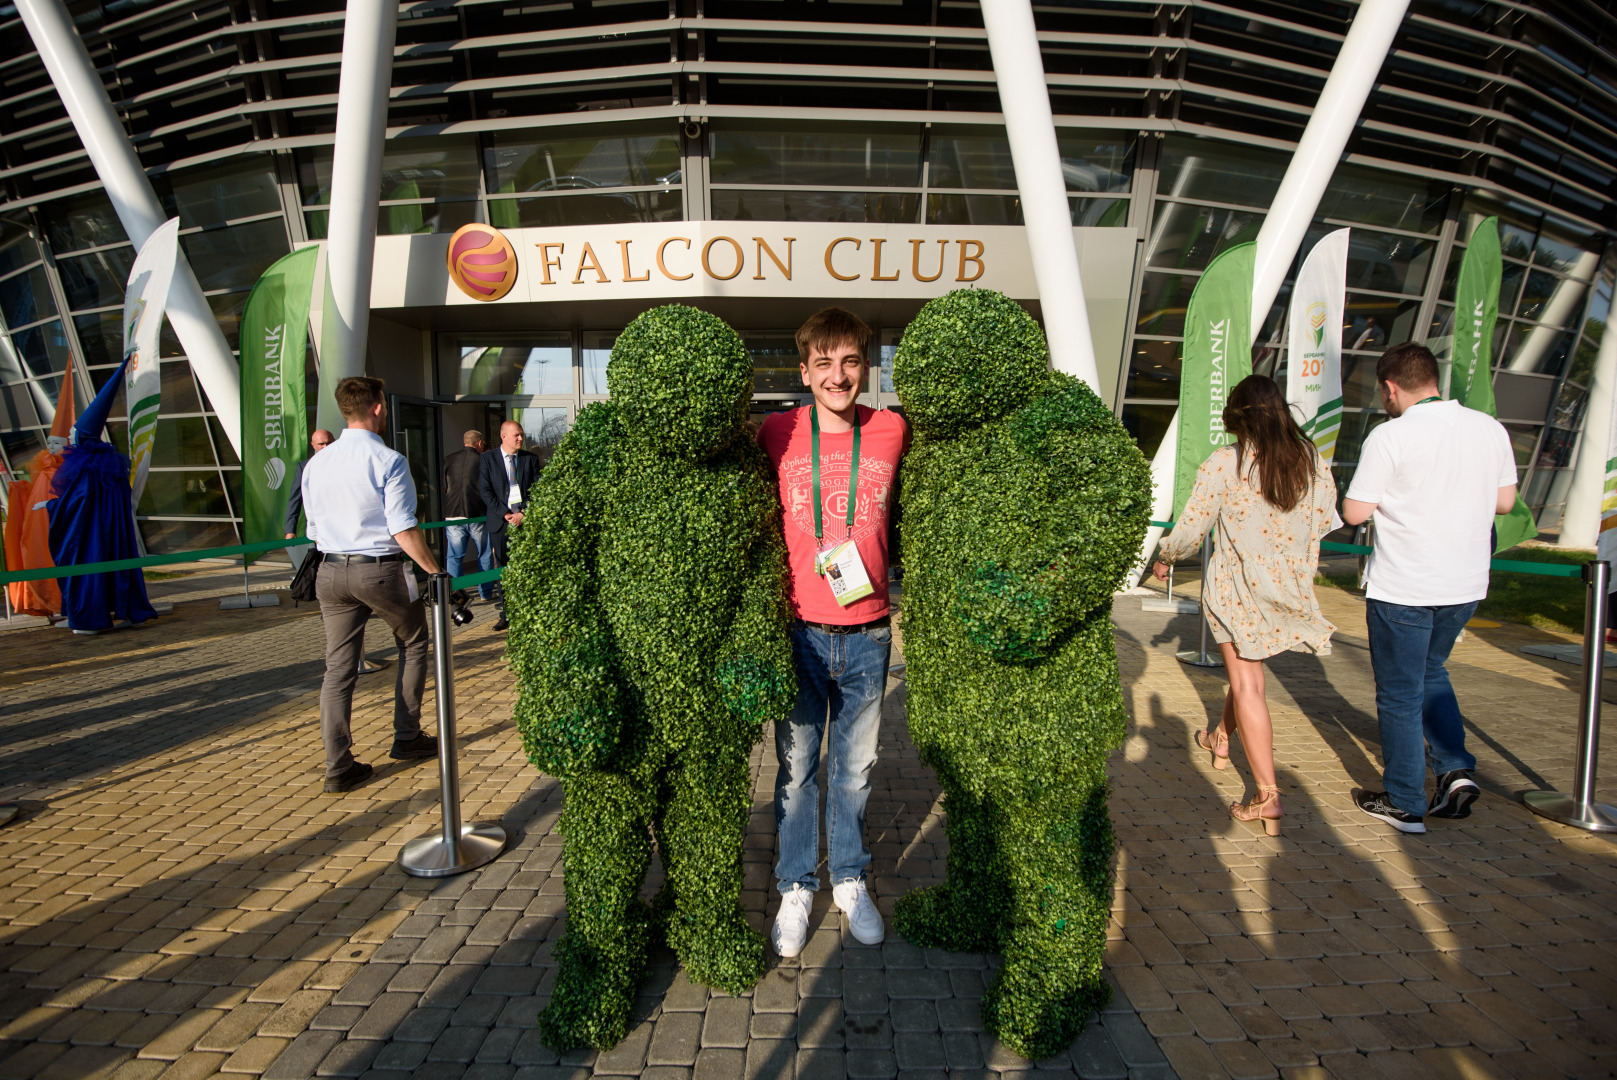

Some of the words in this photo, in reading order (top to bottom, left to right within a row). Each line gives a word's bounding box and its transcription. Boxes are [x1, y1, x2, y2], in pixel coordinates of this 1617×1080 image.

[535, 236, 797, 285] FALCON
[824, 237, 987, 283] CLUB
[264, 324, 282, 450] SBERBANK
[1209, 319, 1225, 446] SBERBANK
[782, 453, 829, 471] Upholng
[830, 450, 846, 462] the
[820, 478, 865, 487] BOGNR
[836, 496, 849, 513] B
